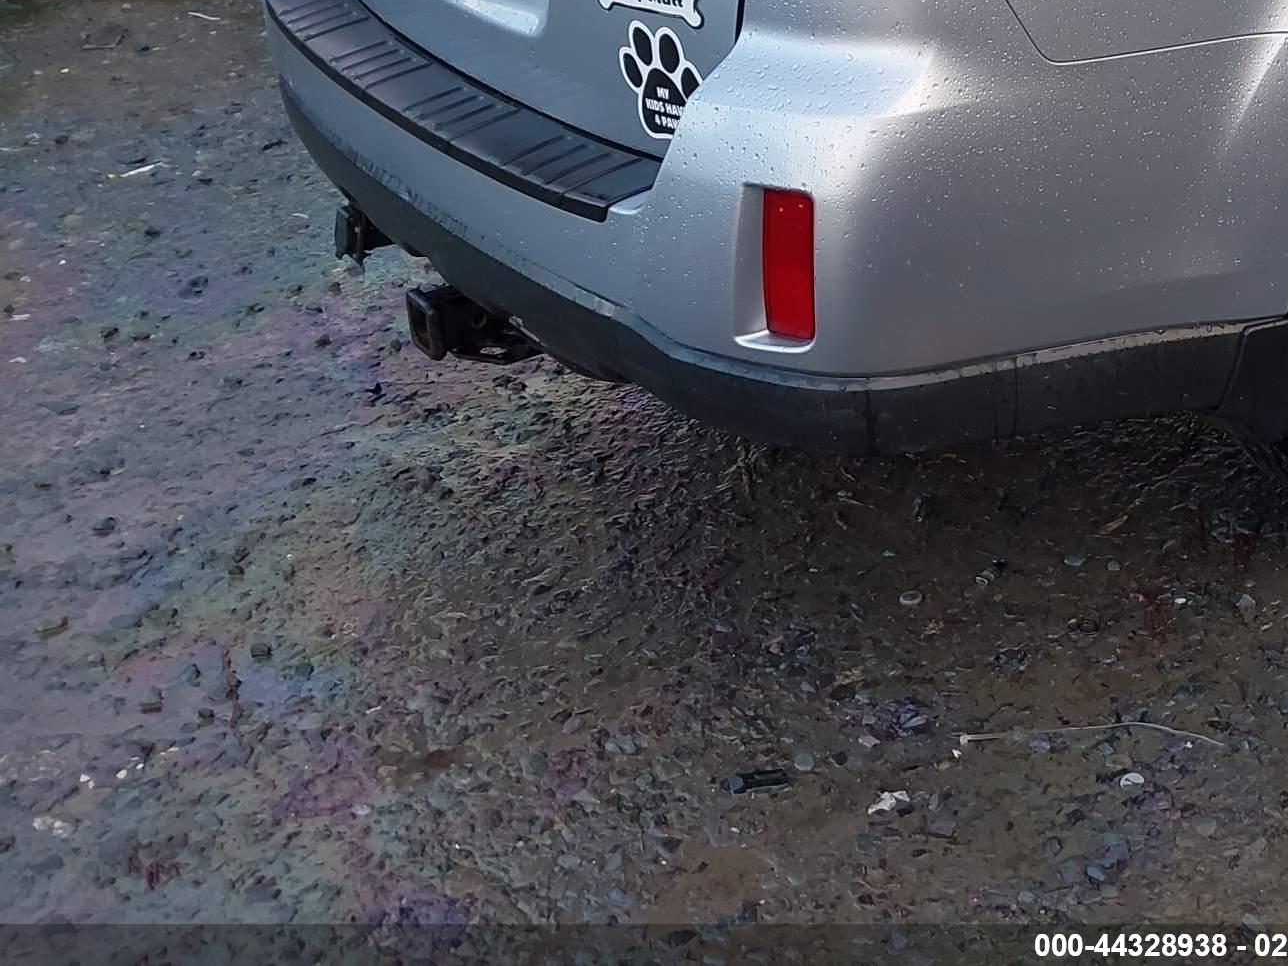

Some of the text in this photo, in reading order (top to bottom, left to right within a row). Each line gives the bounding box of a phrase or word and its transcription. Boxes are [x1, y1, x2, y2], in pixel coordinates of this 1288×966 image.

[656, 86, 670, 100] MY
[645, 97, 684, 117] KIDS HAV
[654, 113, 680, 130] 4 PAW
